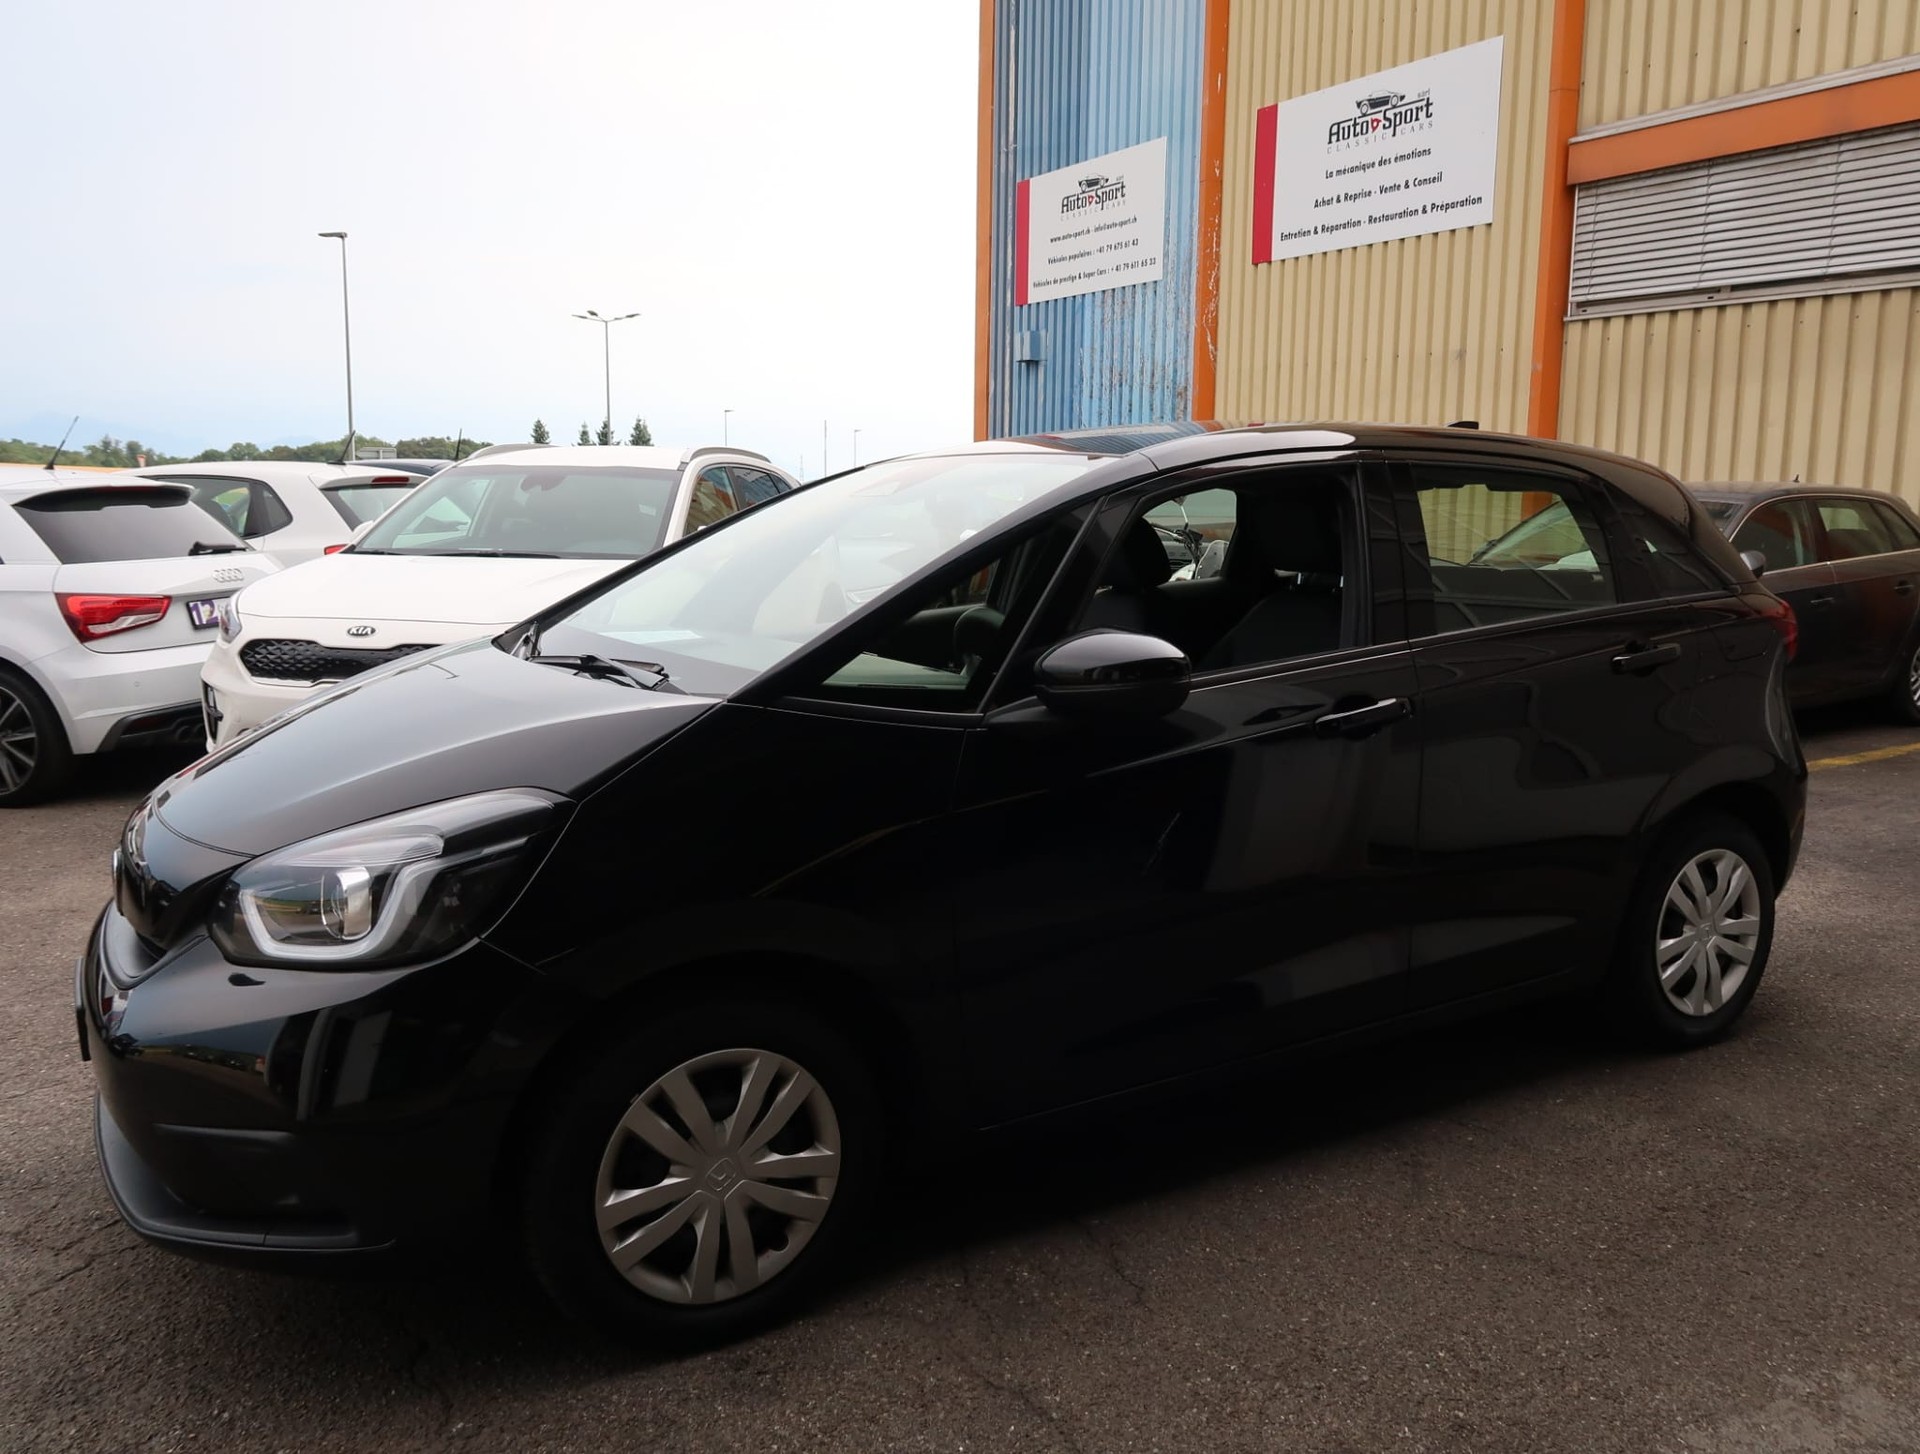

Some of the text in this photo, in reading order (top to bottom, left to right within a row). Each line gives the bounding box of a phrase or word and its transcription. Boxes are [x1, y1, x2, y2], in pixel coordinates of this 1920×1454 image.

[1326, 120, 1433, 155] CLASSIC CARS
[1327, 97, 1434, 145] Auto Sport
[1325, 147, 1432, 180] La mécanique des émotions
[1061, 181, 1126, 214] Auto Sport
[1313, 196, 1334, 209] Achat
[1335, 194, 1342, 204] &
[1343, 188, 1372, 203] Reprise
[1379, 182, 1401, 195] Vente
[1403, 179, 1410, 189] &
[1412, 171, 1443, 188] Conseil
[1280, 227, 1311, 242] Entretien
[1313, 225, 1319, 235] &
[1321, 217, 1362, 235] Réparation
[1368, 206, 1419, 225] Restauration
[1421, 204, 1428, 214] &
[1430, 194, 1483, 213] Préparation
[349, 625, 373, 636] KIA
